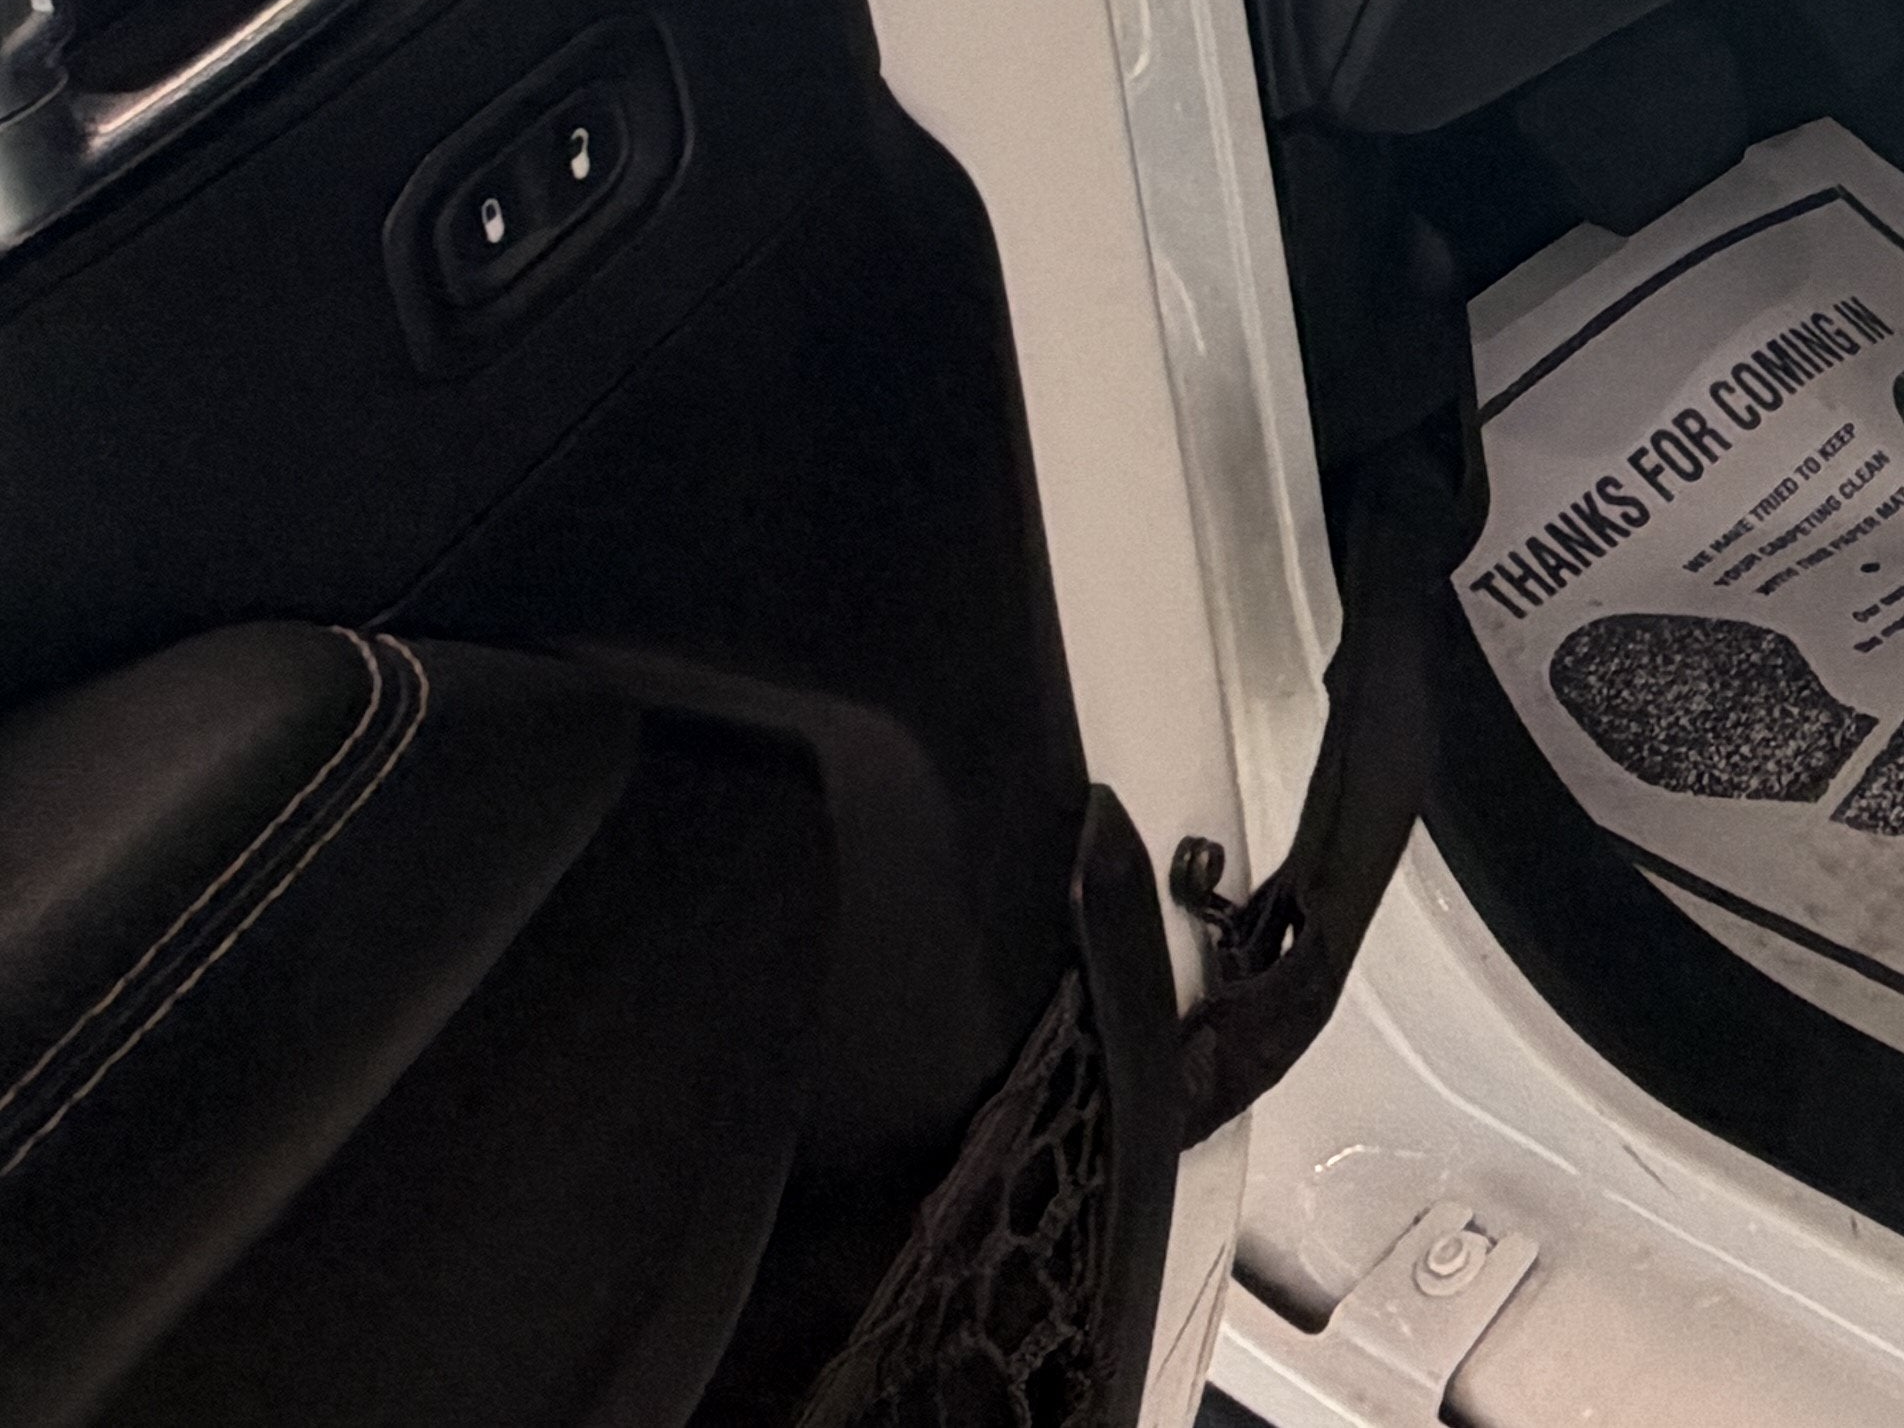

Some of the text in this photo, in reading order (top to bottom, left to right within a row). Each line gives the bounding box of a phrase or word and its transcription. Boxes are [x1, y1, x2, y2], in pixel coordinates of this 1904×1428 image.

[1470, 296, 1894, 619] THANKS FOR COMING IN
[1683, 551, 1712, 573] WE
[1749, 477, 1799, 519] TRIED
[1795, 455, 1822, 482] TO
[1818, 422, 1857, 462] KEEP
[1714, 450, 1891, 586] YOUR CARPETING CLEAN
[1830, 515, 1881, 551] PAPER
